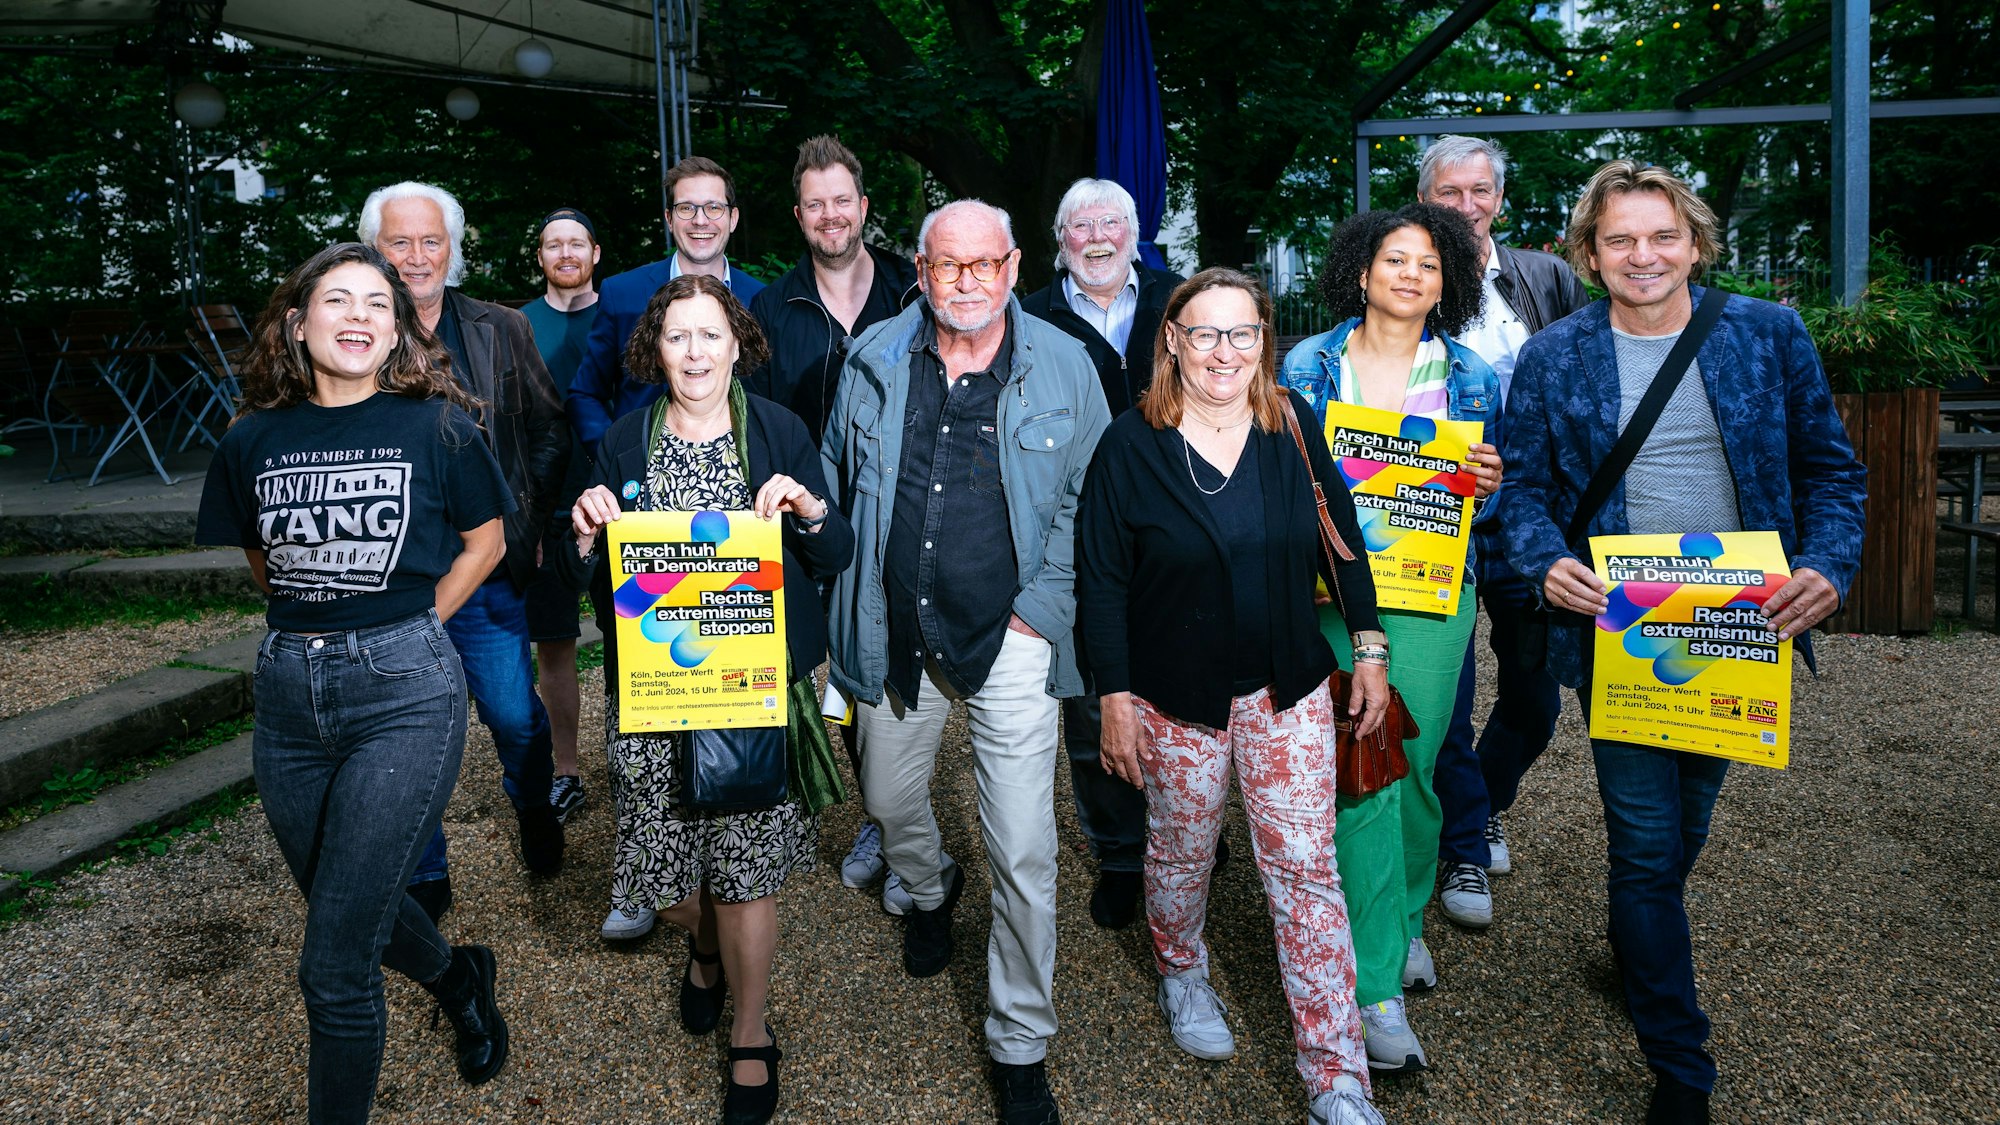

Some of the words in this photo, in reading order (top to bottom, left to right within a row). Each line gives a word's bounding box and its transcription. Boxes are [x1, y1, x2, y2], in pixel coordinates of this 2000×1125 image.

[1335, 428, 1383, 447] Arsch
[1388, 436, 1419, 453] huh
[266, 458, 275, 469] 9.
[279, 450, 364, 466] NOVEMBER
[370, 448, 402, 459] 1992
[1333, 442, 1357, 456] für
[1360, 448, 1457, 473] Demokratie
[262, 473, 326, 508] ARSCH
[333, 474, 395, 493] huh,
[1396, 484, 1462, 505] Rechts-
[1354, 494, 1460, 522] extremismus
[1390, 514, 1458, 536] stoppen
[622, 543, 676, 558] Arsch
[680, 543, 715, 557] huh
[623, 560, 648, 573] für
[654, 558, 759, 572] Demokratie
[1608, 556, 1666, 567] Arsch
[1671, 557, 1710, 568] huh
[1609, 568, 1638, 581] für
[1644, 569, 1763, 585] Demokratie
[700, 592, 772, 605] Rechts-
[657, 606, 773, 620] extremismus
[700, 621, 774, 636] stoppen
[1642, 624, 1777, 644] extremismus
[1690, 642, 1776, 662] stoppen
[722, 672, 745, 680] QUER
[1607, 691, 1650, 701] Samstag,
[1634, 684, 1671, 693] Deutzer
[1674, 687, 1701, 696] Werft
[677, 700, 762, 709] rechtsextremismus-stoppen.de
[1644, 702, 1670, 711] 2024,
[1687, 706, 1704, 715] Uhr
[1656, 719, 1758, 738] rechtsextremismus-stoppen.de
